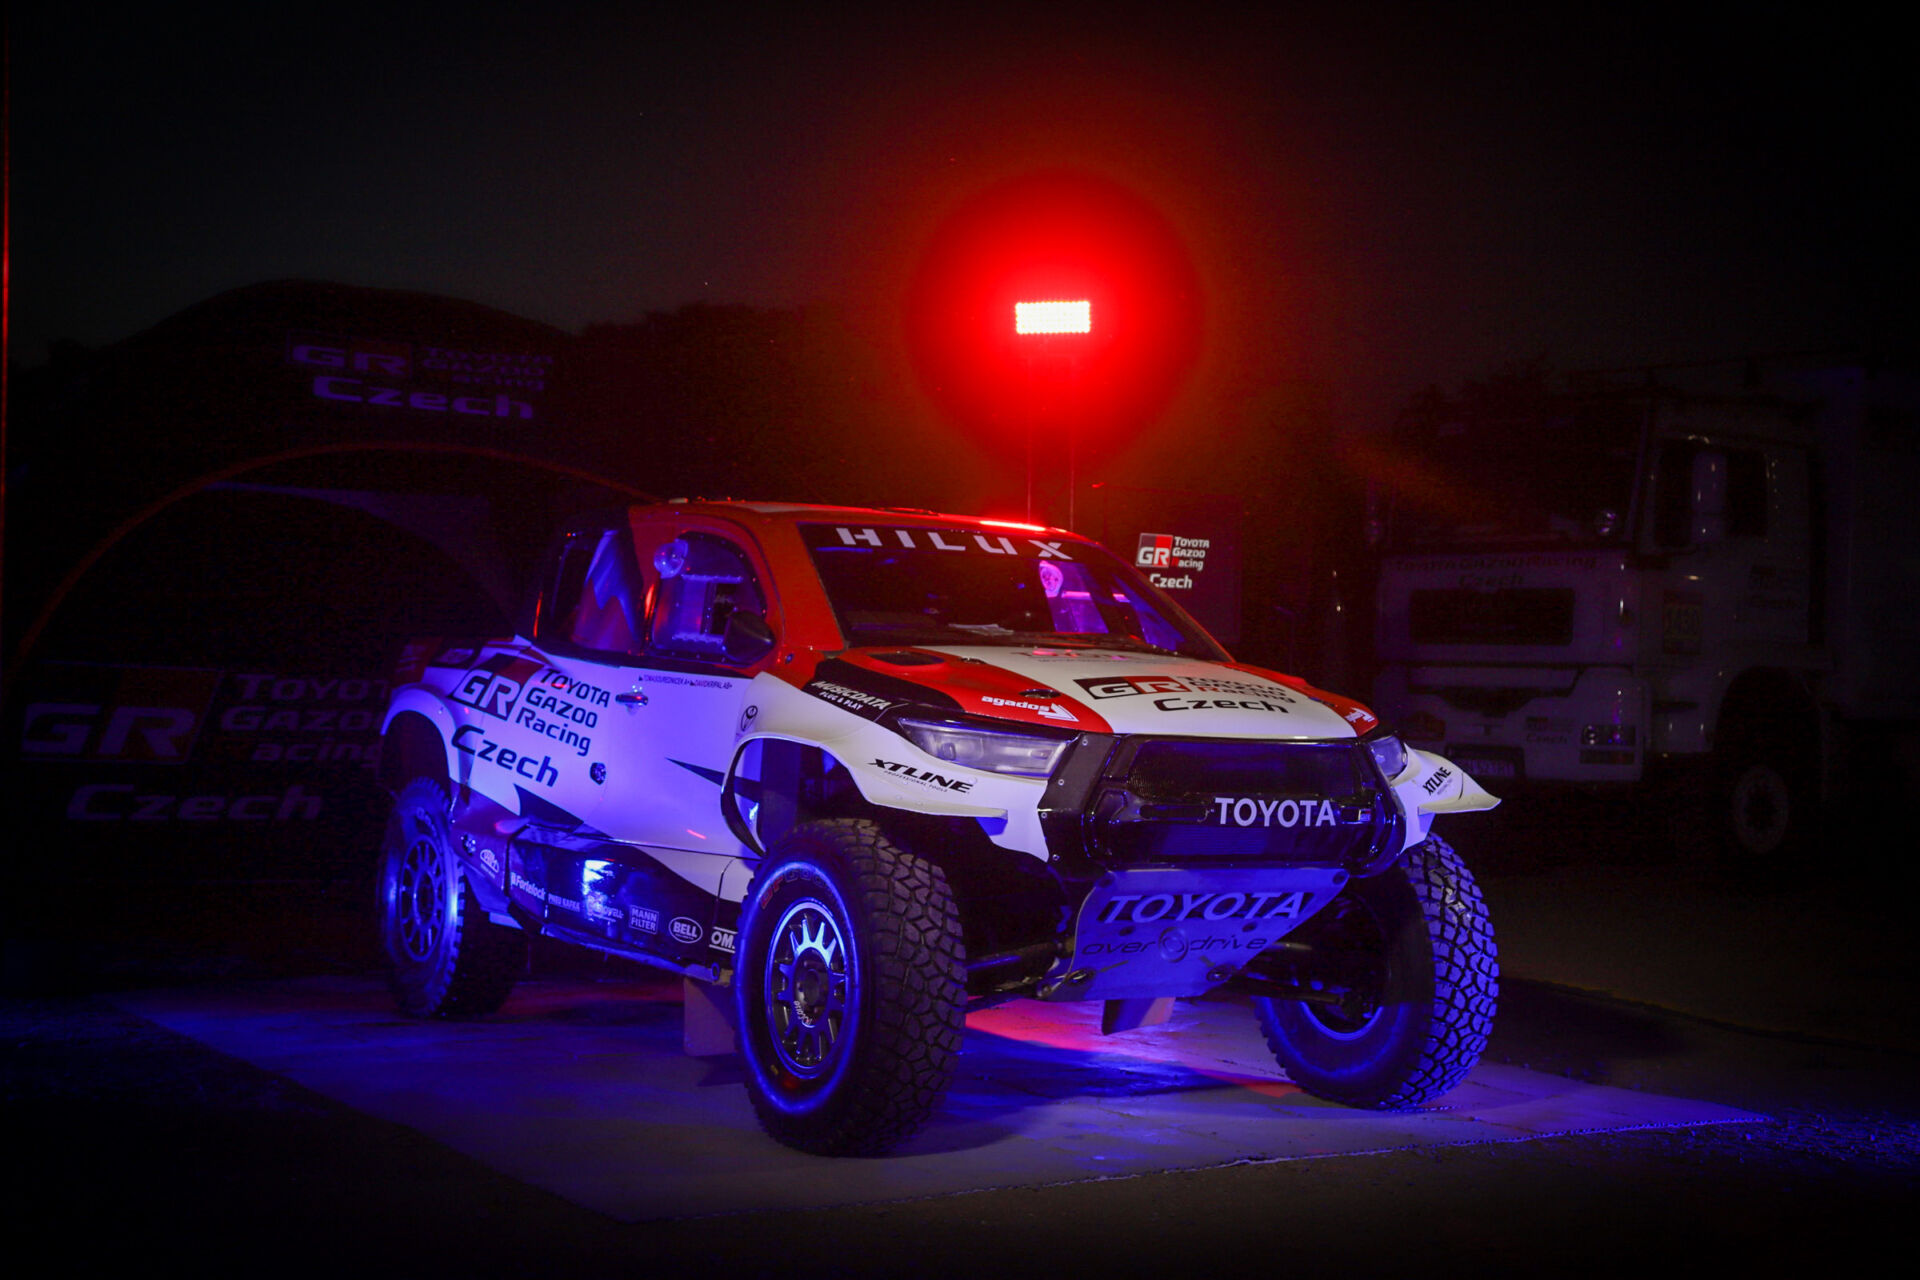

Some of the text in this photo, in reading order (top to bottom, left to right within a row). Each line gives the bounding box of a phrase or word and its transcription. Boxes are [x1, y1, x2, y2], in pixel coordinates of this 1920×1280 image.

[312, 374, 534, 420] Czech
[836, 527, 1073, 560] HILUX
[1138, 546, 1170, 566] GR
[1172, 547, 1206, 558] GAZOO
[1174, 536, 1210, 548] TOYOTA
[1150, 573, 1193, 589] Czech
[453, 669, 521, 721] GR
[540, 669, 611, 708] TOYOTA
[981, 695, 1050, 712] agados
[1090, 680, 1186, 699] GR
[526, 687, 598, 729] GAZOO
[1154, 697, 1290, 714] Czech
[21, 702, 197, 757] GR
[515, 706, 591, 757] Racing
[451, 724, 559, 788] Czech
[868, 758, 973, 794] XTLINE
[1422, 766, 1452, 796] XTLINE
[66, 783, 325, 822] Czech
[1215, 797, 1336, 828] TOYOTA
[632, 908, 658, 922] MANN
[1103, 892, 1306, 924] TOYOTA
[631, 917, 657, 931] FILTER
[673, 921, 698, 938] BELL
